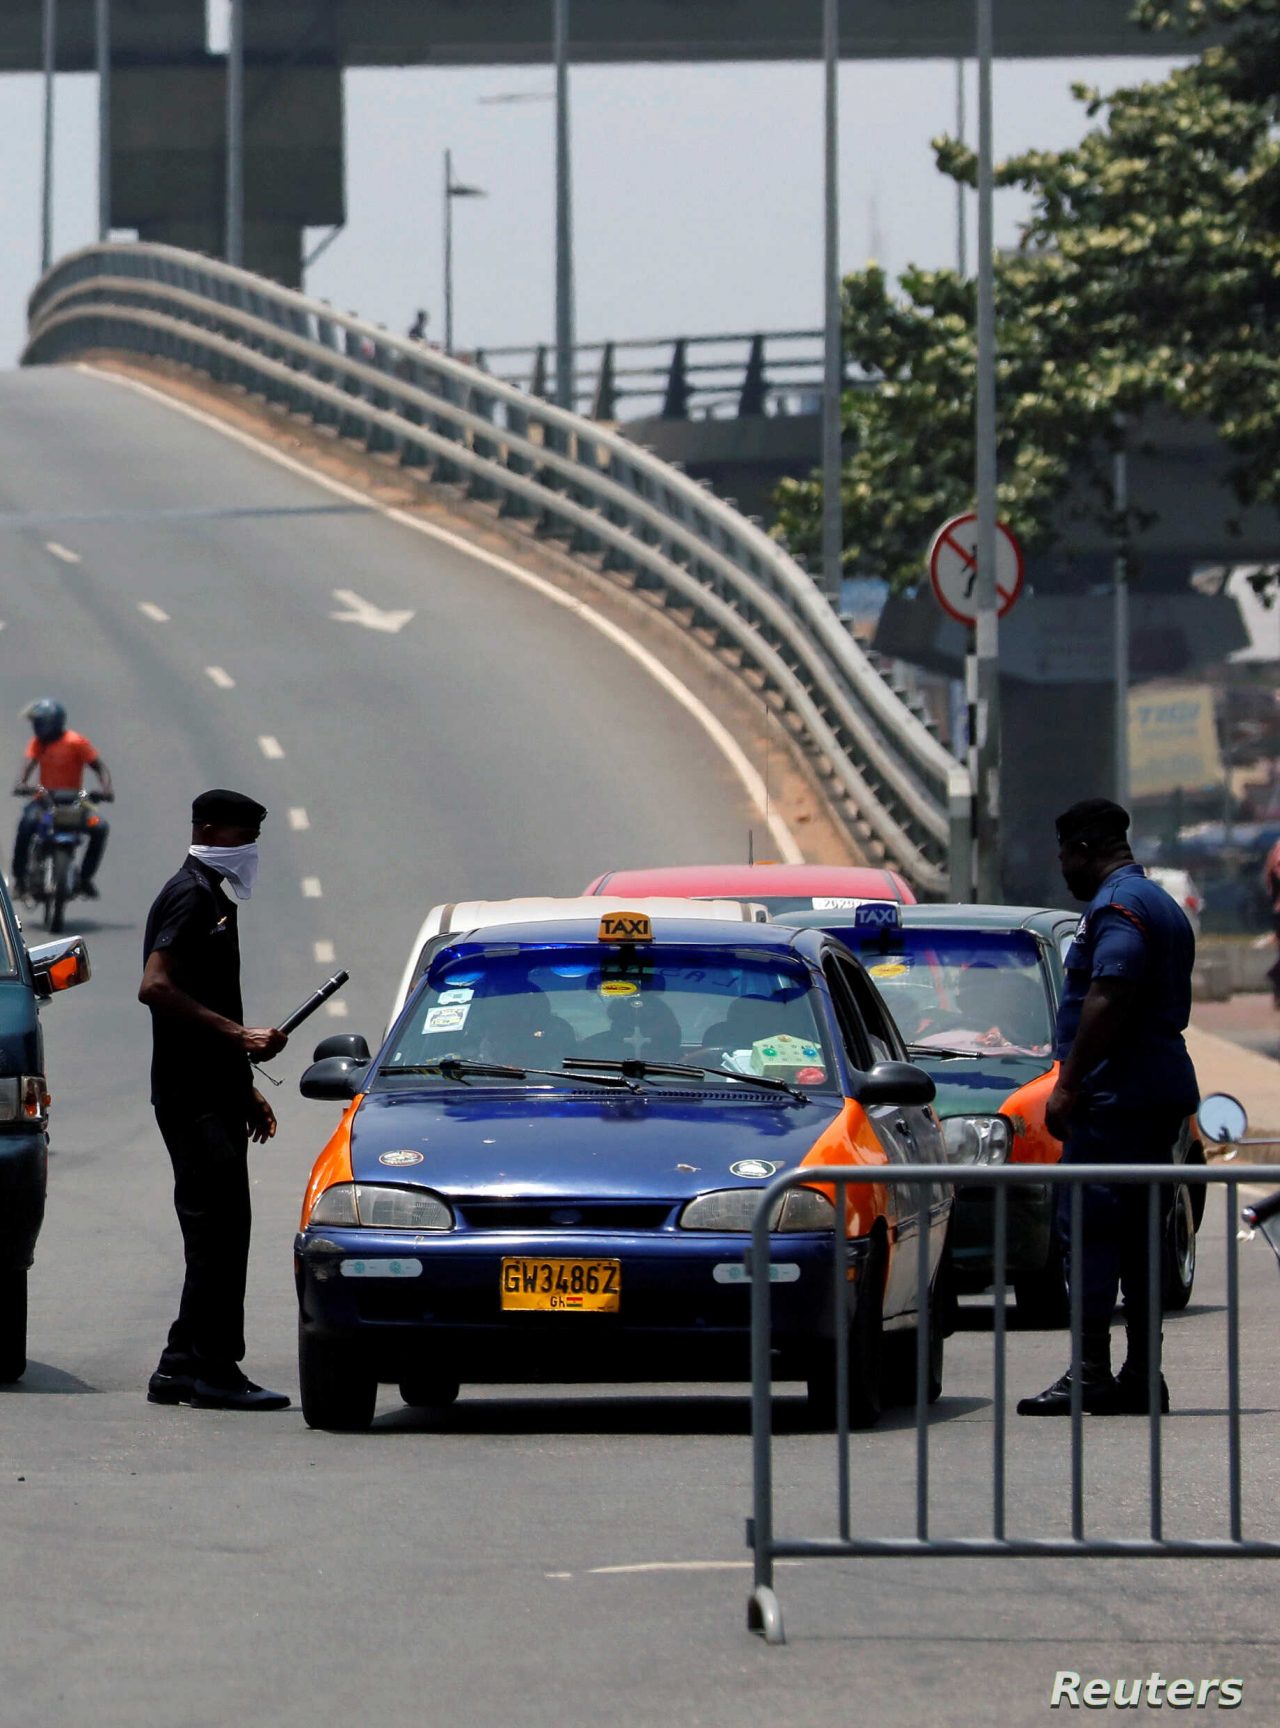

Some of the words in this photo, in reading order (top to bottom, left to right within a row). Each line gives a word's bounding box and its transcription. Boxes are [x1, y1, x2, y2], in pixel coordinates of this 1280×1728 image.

[856, 909, 897, 924] TAXI
[600, 918, 649, 935] TAXI
[504, 1262, 619, 1294] GW3486Z
